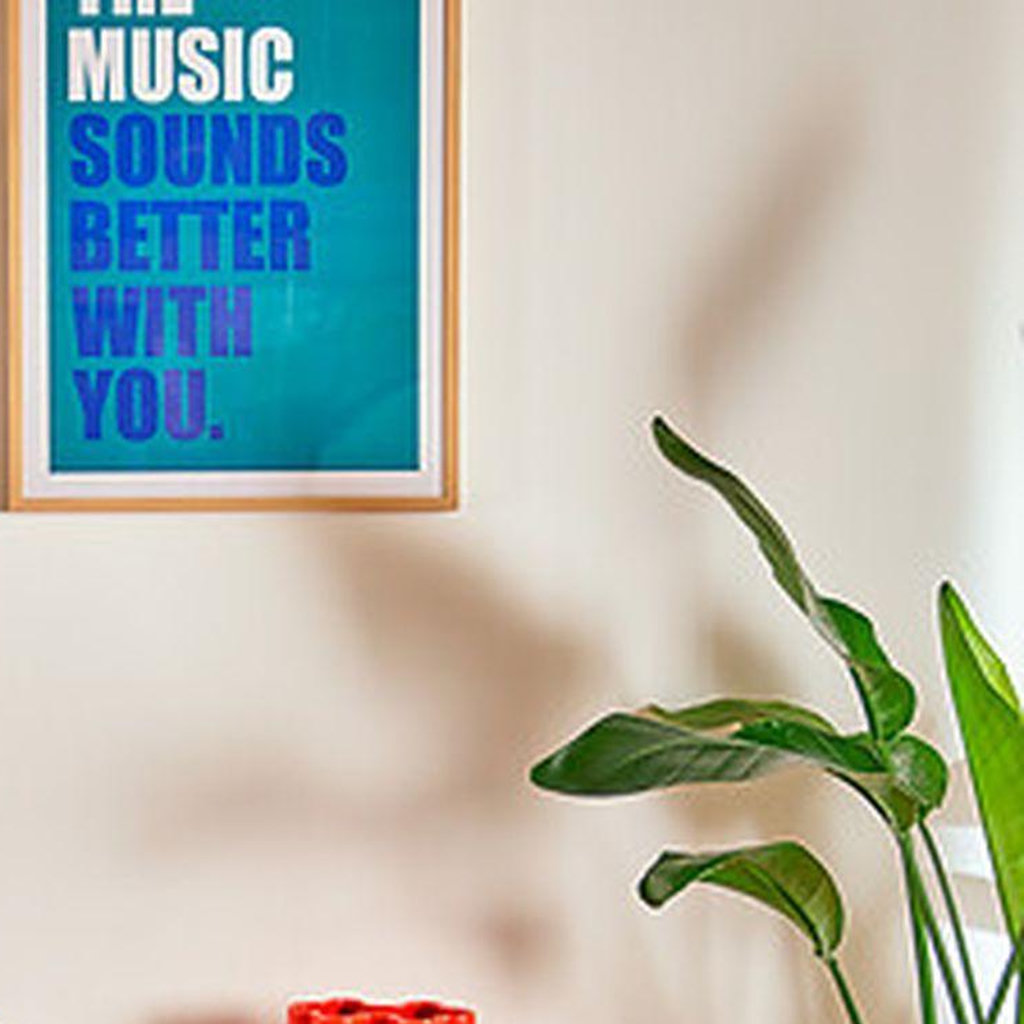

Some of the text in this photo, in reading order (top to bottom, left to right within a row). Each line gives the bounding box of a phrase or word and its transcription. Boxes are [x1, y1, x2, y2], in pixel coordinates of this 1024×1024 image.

[69, 27, 293, 103] MUSIC
[68, 111, 348, 188] SOUNDS
[69, 200, 311, 272] BETTER
[72, 286, 253, 358] WITH
[72, 369, 224, 442] YOU.
